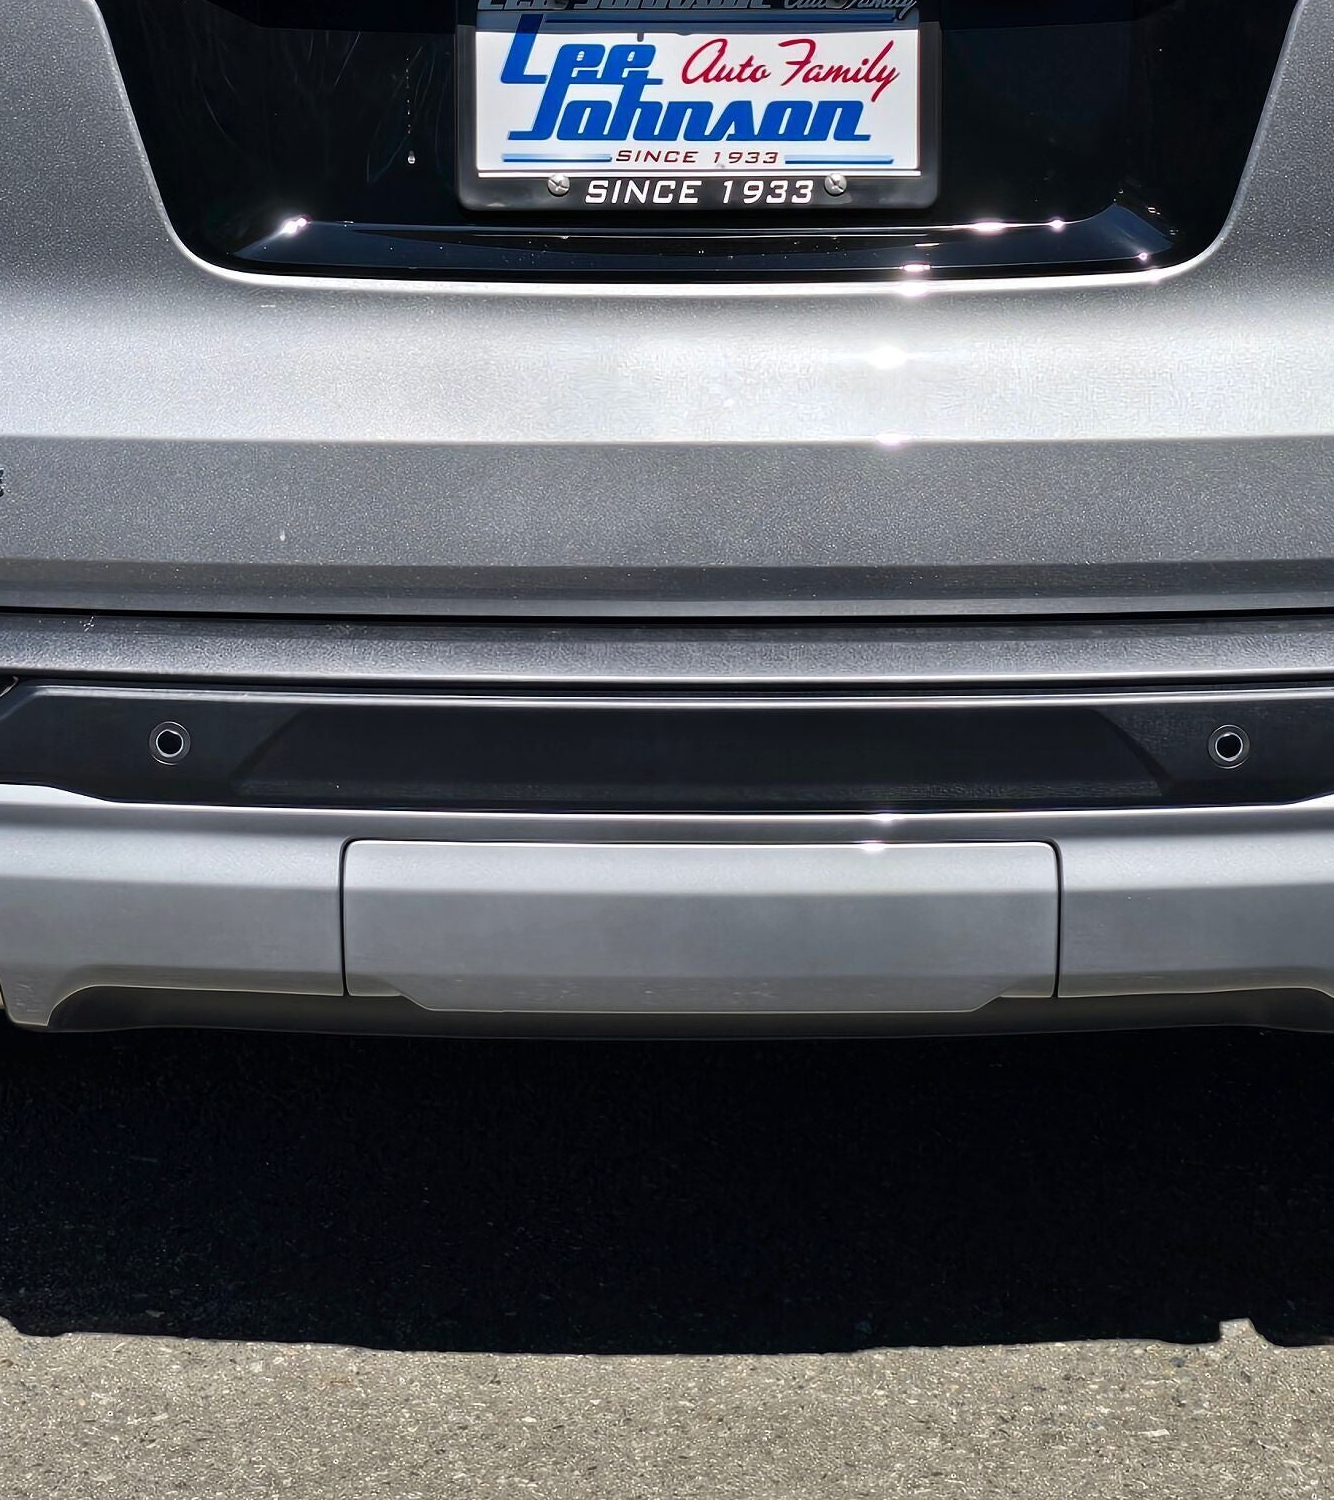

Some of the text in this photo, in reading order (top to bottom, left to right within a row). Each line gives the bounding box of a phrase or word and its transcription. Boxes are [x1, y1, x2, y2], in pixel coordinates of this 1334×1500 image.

[500, 14, 664, 85] Lee
[681, 38, 901, 102] Auto Family
[507, 85, 871, 141] Johnson
[615, 150, 780, 165] SINCE 1933
[584, 180, 814, 205] SINCE 1933
